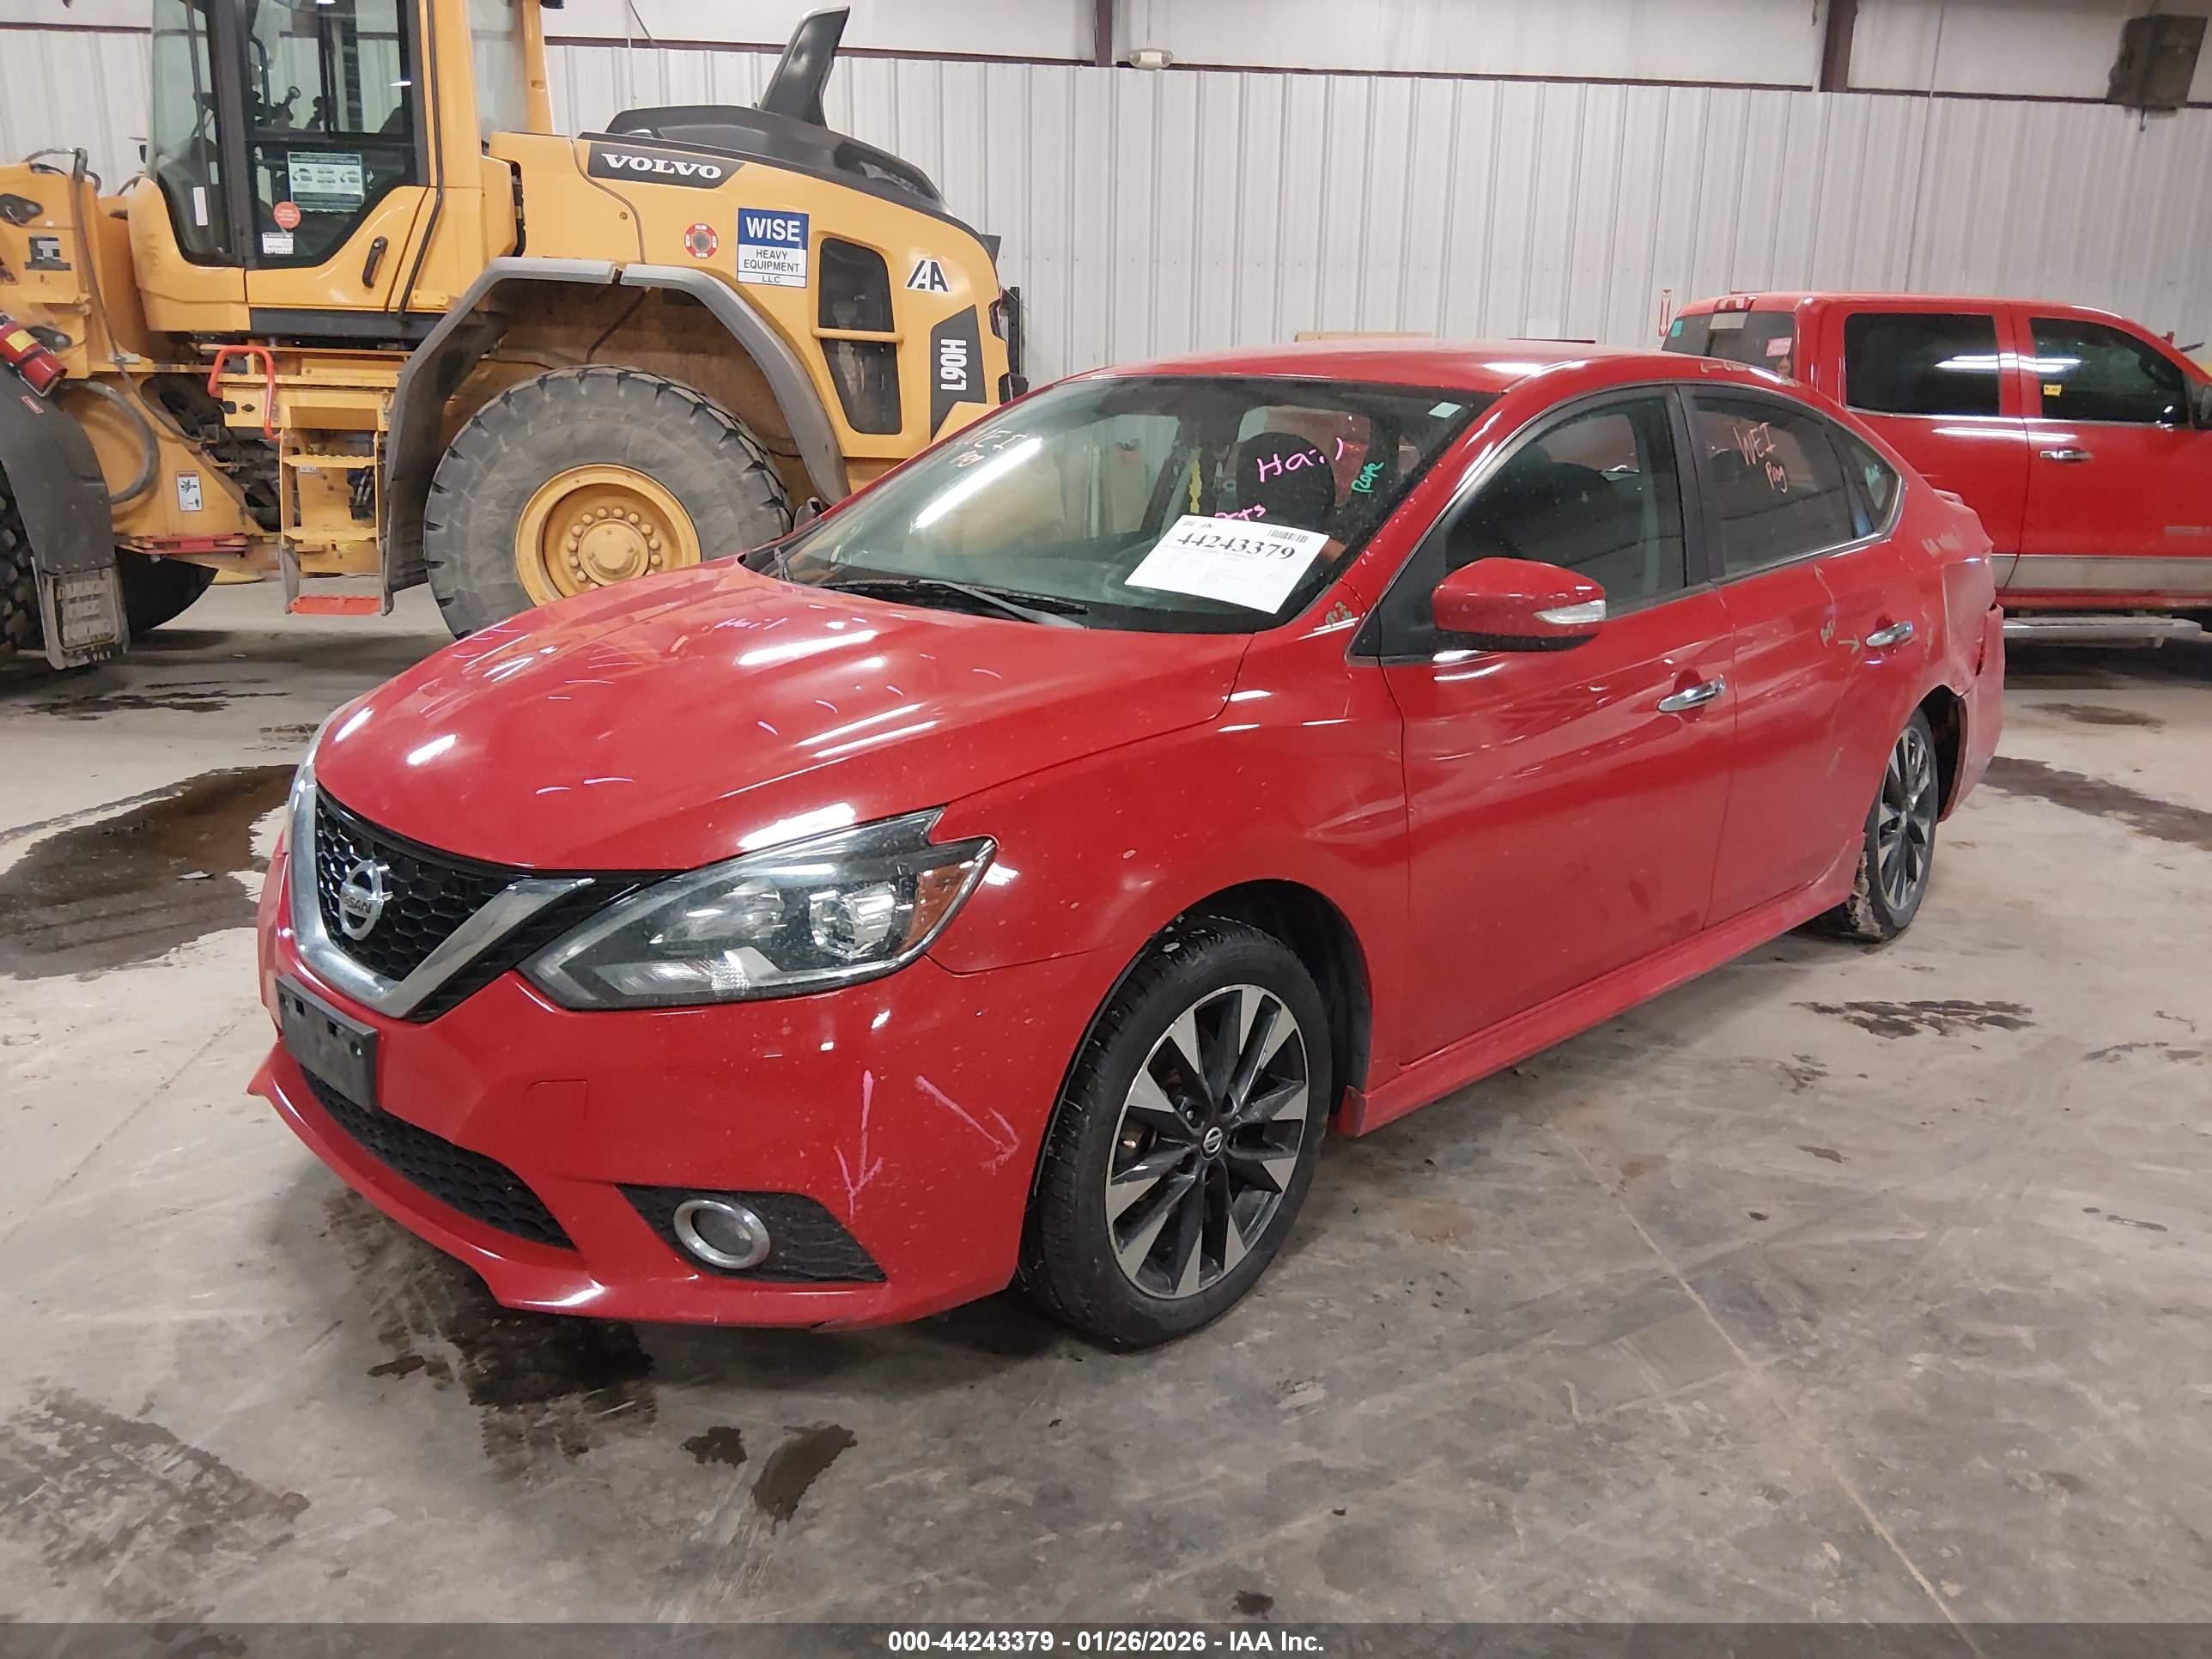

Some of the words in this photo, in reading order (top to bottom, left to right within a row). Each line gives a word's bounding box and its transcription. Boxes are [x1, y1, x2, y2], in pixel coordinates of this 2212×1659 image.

[601, 153, 722, 179] VOLVO
[745, 216, 801, 242] WISE
[744, 258, 800, 273] EQUIPMENT
[756, 249, 788, 260] HEAVY
[762, 275, 781, 284] LLC
[940, 338, 967, 392] L90H
[1177, 533, 1296, 560] 44243379
